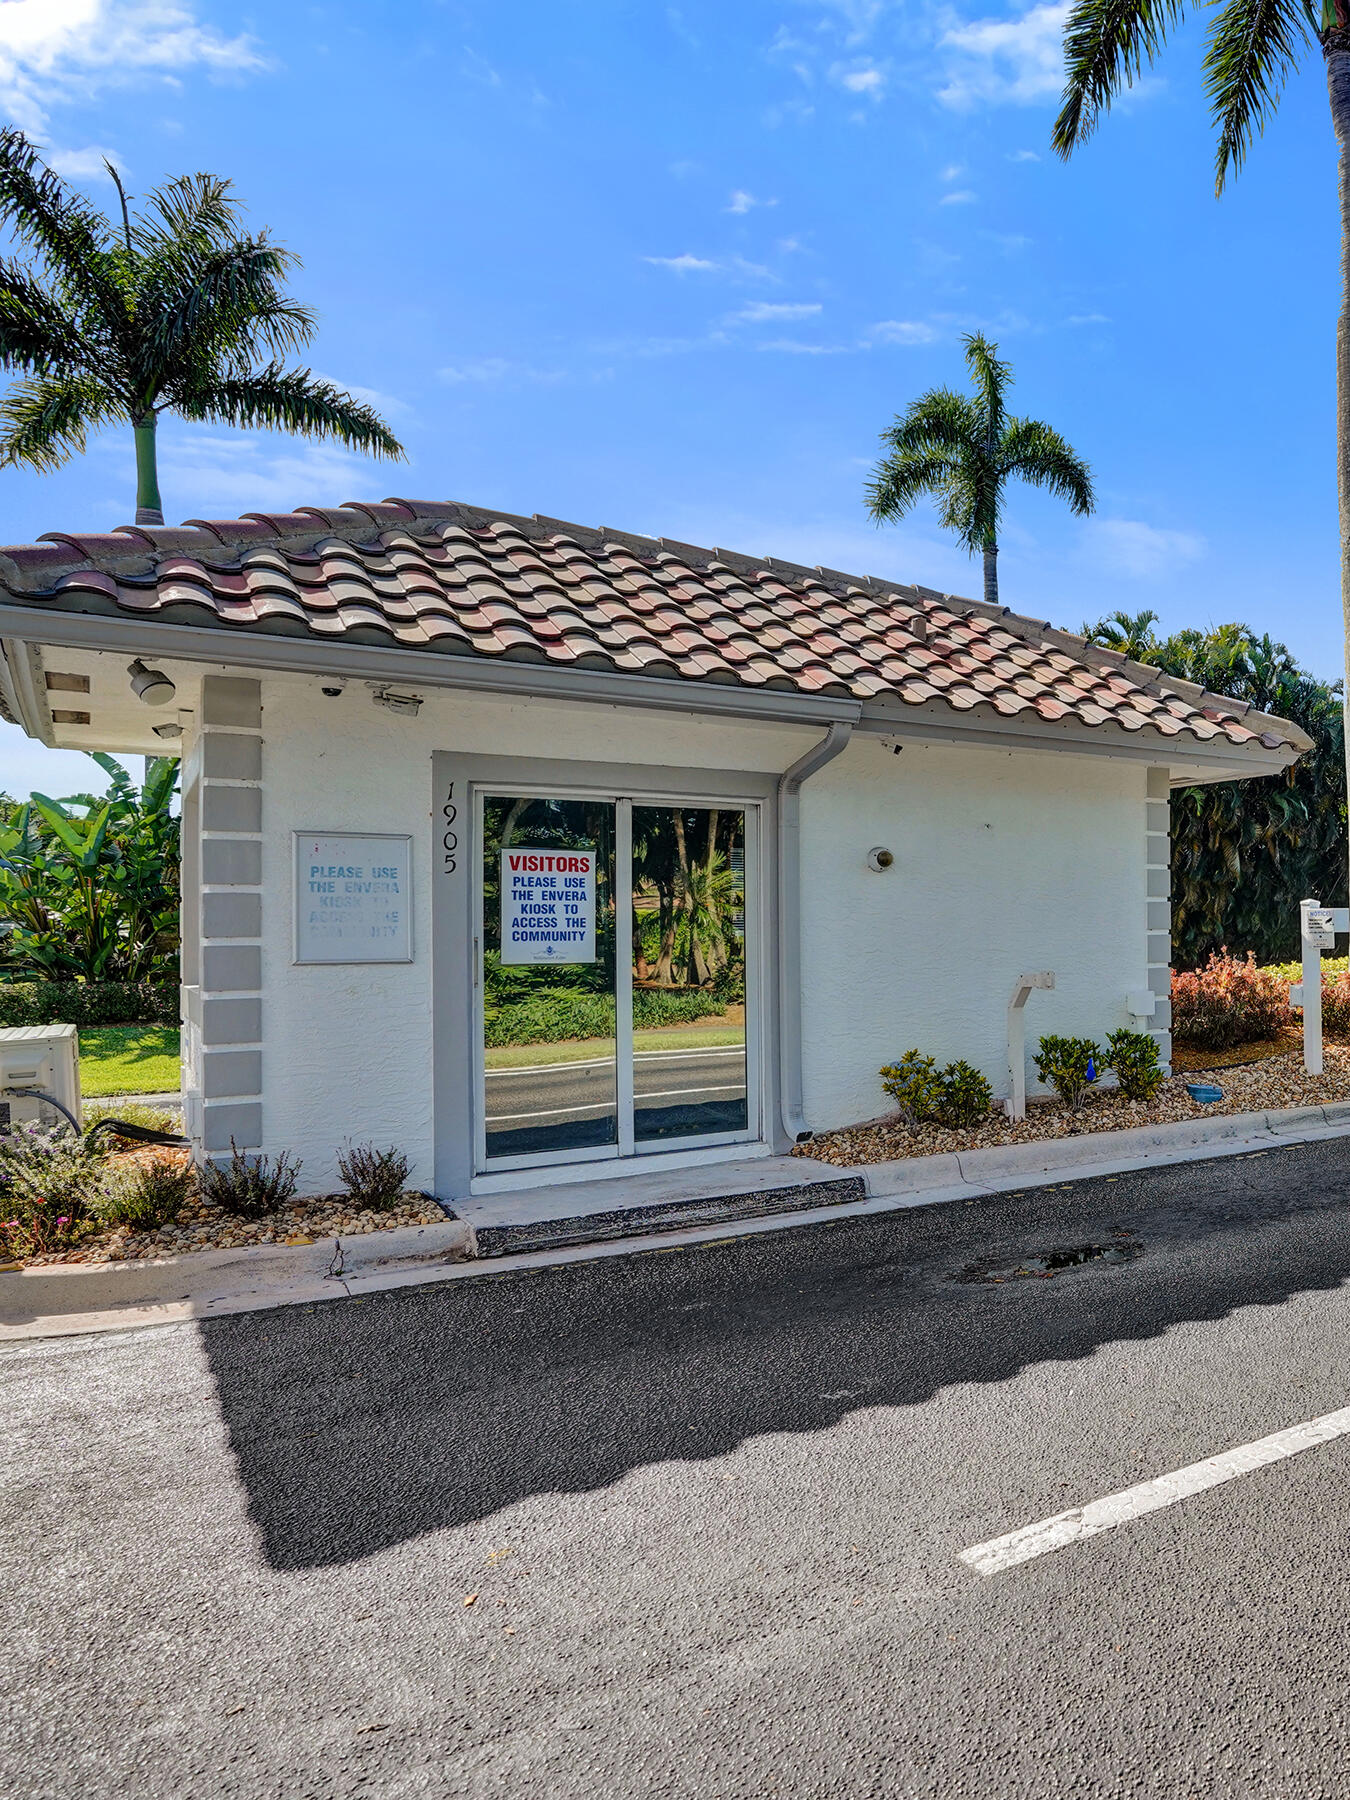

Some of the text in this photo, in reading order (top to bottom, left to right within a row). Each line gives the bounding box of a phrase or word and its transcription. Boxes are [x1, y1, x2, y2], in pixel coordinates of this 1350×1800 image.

[443, 782, 457, 874] 1905
[509, 855, 590, 873] VISITORS
[310, 865, 398, 879] PLEASE USE
[308, 881, 336, 893] THE
[513, 876, 586, 889] PLEASE USE
[511, 890, 587, 901] THE ENVERA
[521, 903, 578, 915] KIOSK TO
[511, 917, 586, 928] ACCESS THE
[512, 931, 586, 942] COMMUNITY
